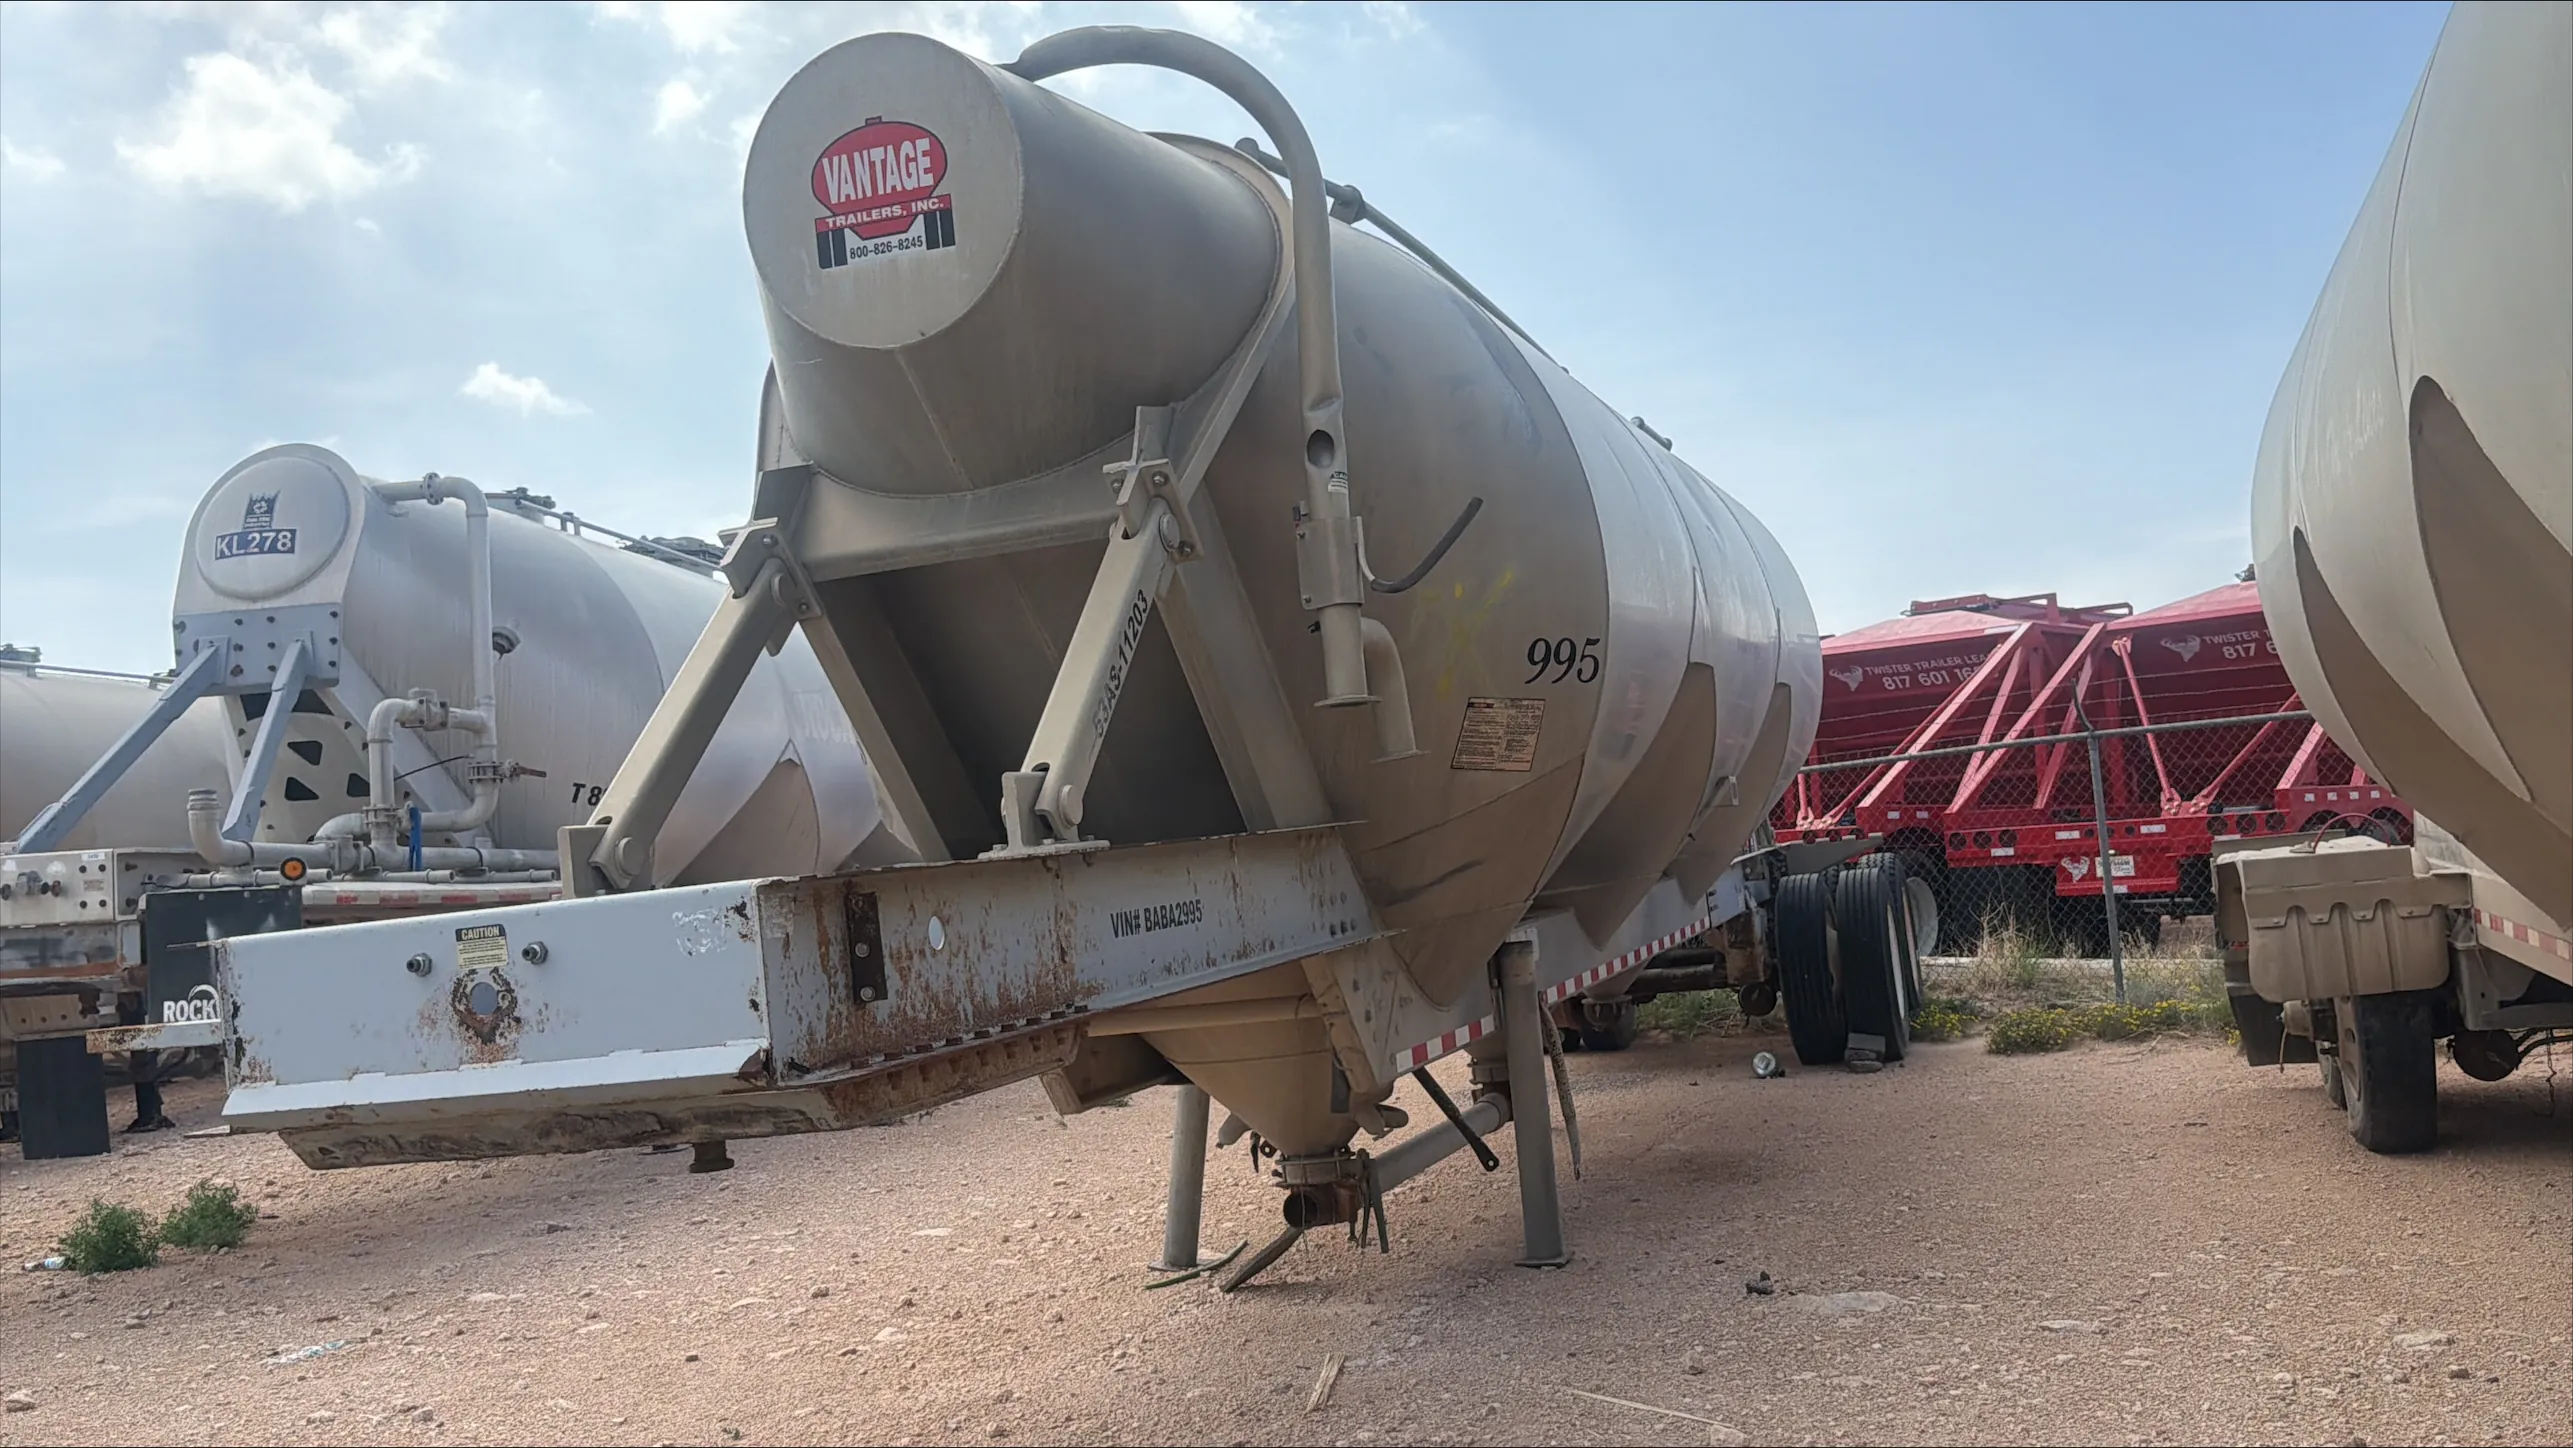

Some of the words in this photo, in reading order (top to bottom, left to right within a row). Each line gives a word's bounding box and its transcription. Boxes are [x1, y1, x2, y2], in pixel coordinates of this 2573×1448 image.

[821, 137, 934, 204] VANTAGE
[826, 205, 907, 228] TRAILERS,
[911, 198, 944, 213] INC.
[849, 235, 923, 259] 800-826-8245
[216, 531, 292, 558] KL278
[2202, 630, 2260, 645] TWISTER
[1524, 637, 1601, 684] 995
[2222, 642, 2256, 659] 817
[1865, 664, 1912, 676] TWISTER
[1914, 656, 1962, 672] TRAILER
[1963, 654, 1988, 665] LEA
[1882, 674, 1911, 690] 817
[1918, 670, 1951, 687] 601
[1954, 667, 1979, 681] 16
[1110, 909, 1141, 939] VIN#
[1144, 899, 1203, 933] BABA2995
[461, 925, 500, 940] CAUTION
[163, 998, 217, 1023] ROCK
